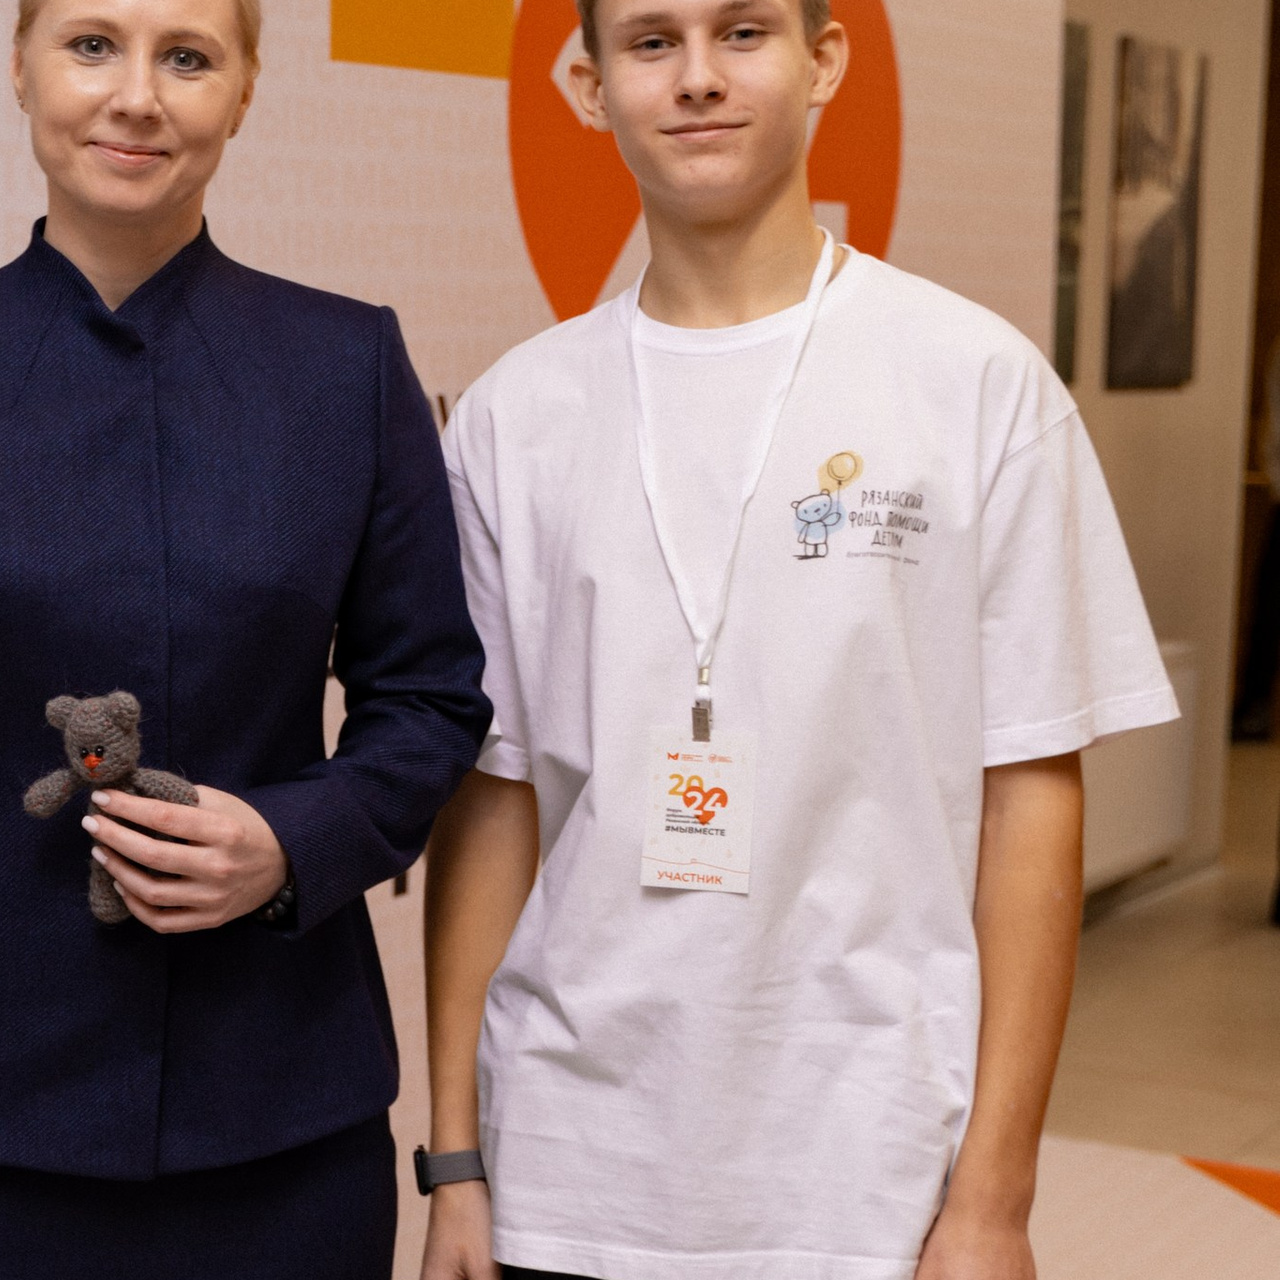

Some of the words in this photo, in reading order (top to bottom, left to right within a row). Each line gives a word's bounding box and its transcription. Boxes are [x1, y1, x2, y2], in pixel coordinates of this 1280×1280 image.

[861, 490, 924, 510] РЯЗАНСКИЙ
[848, 511, 882, 528] ФОНД
[665, 825, 726, 837] #МЫВМЕСТЕ
[657, 871, 723, 885] УЧАСТНИК
